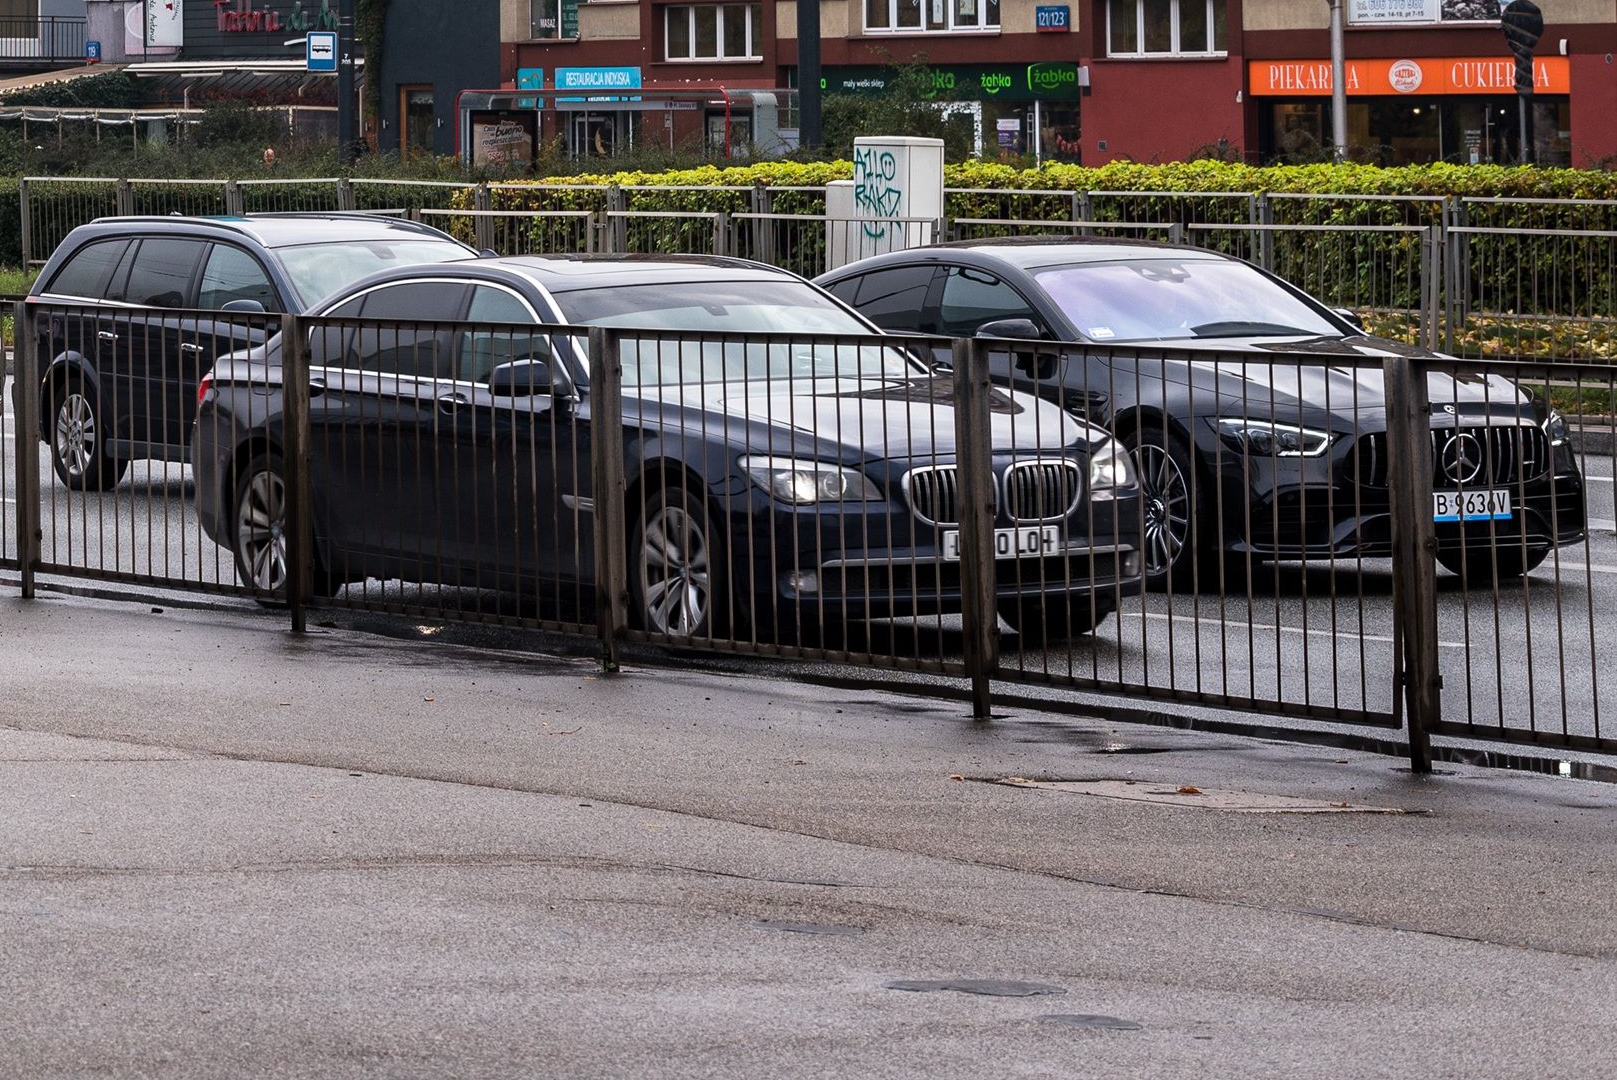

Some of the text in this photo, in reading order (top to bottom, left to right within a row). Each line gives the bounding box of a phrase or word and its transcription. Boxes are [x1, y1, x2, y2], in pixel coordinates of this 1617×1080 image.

[1038, 11, 1065, 27] 121/123
[981, 73, 1011, 87] żabka
[1034, 69, 1075, 83] żabka
[1270, 65, 1360, 89] PIEKARA
[1452, 62, 1550, 88] CUKIERIA
